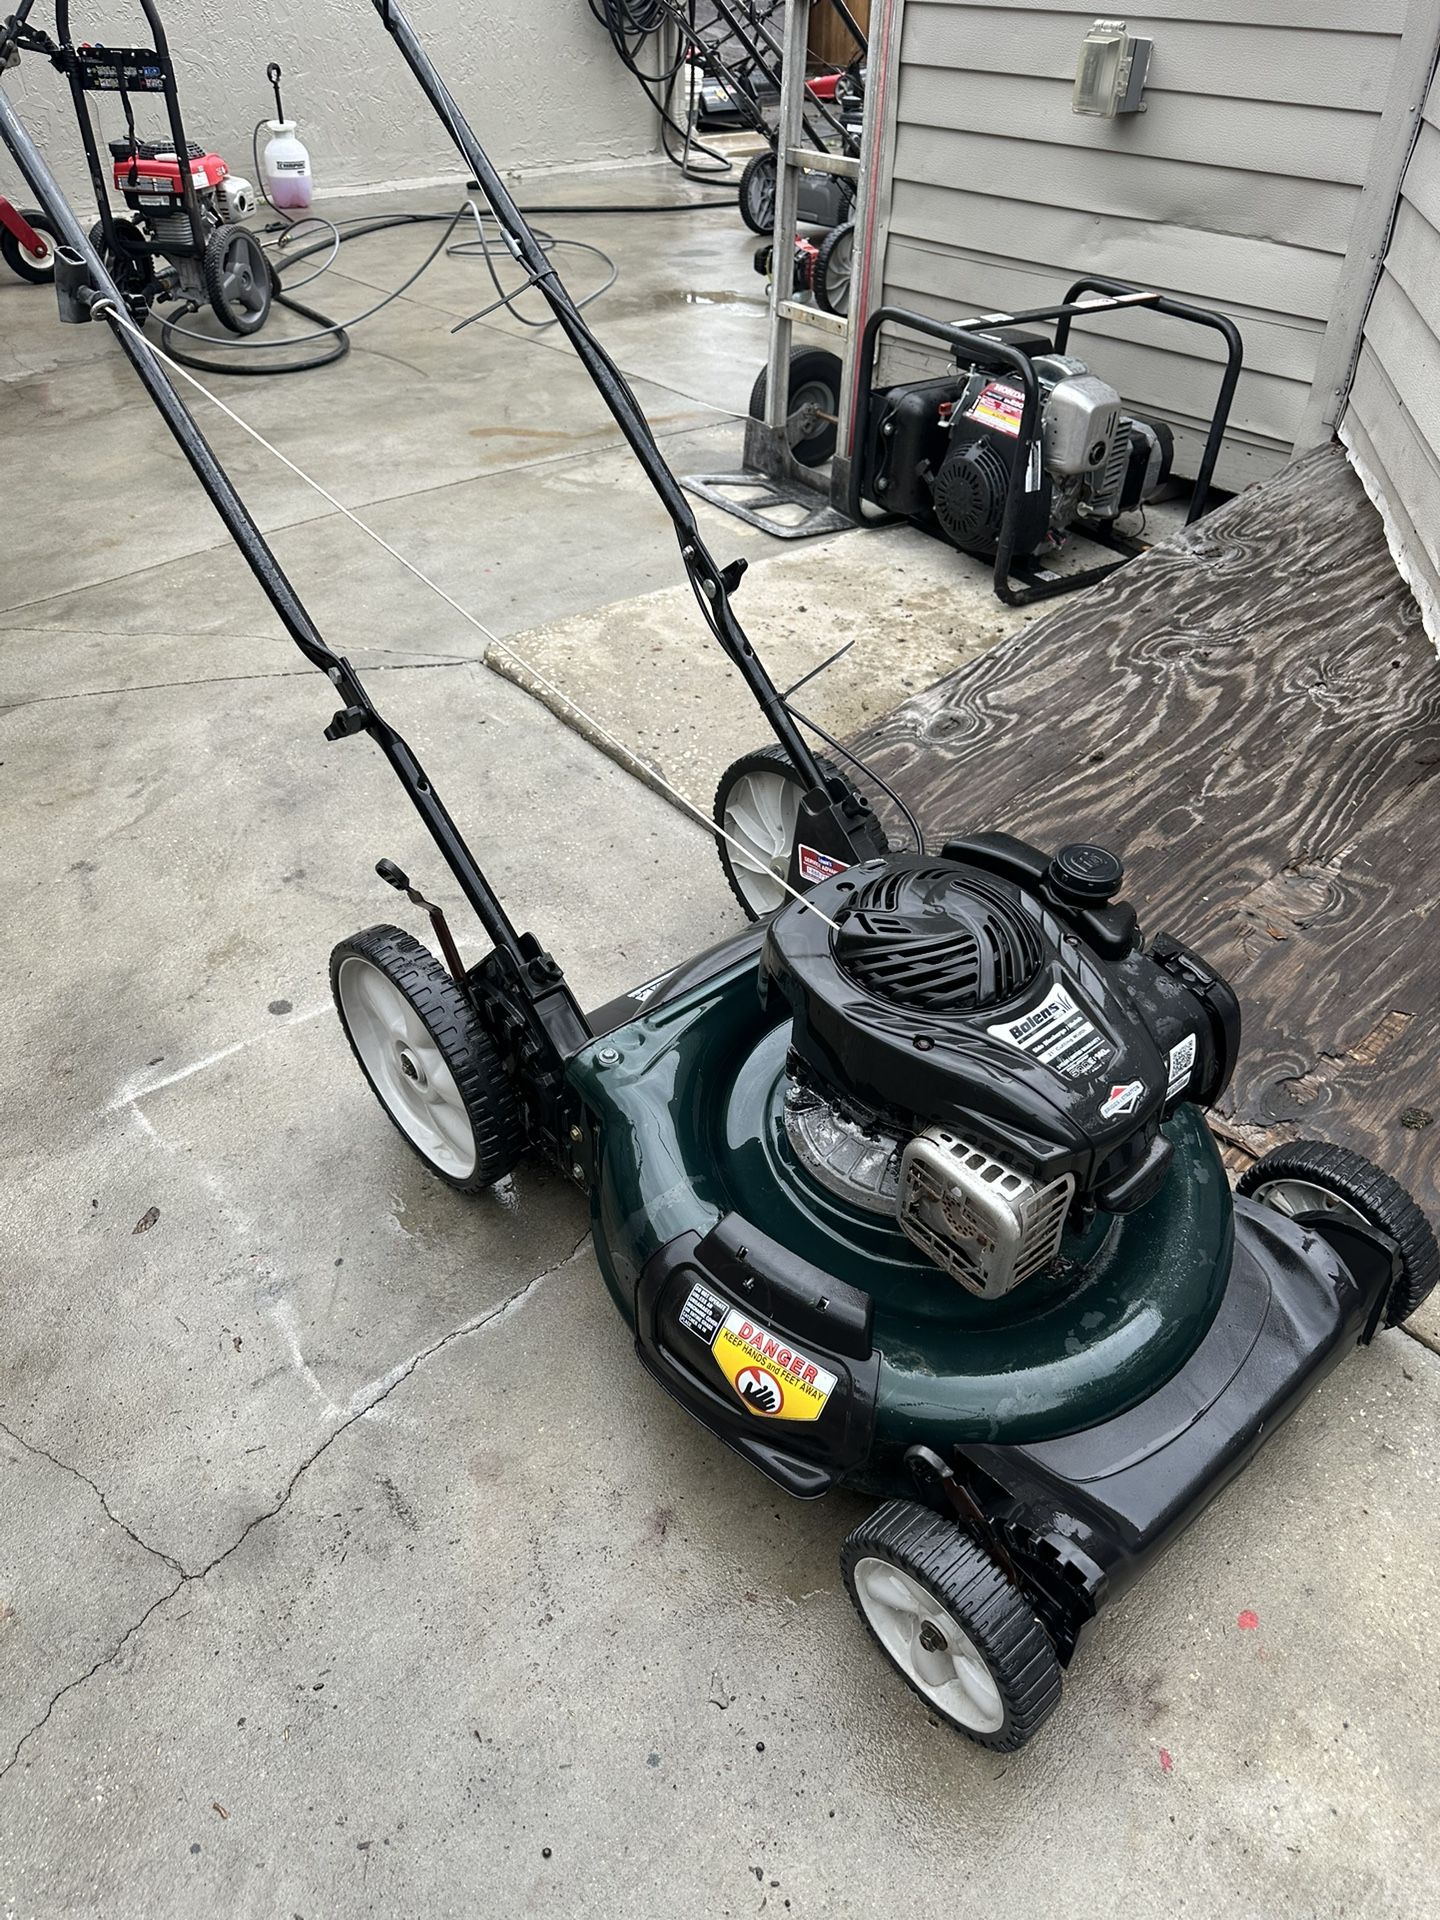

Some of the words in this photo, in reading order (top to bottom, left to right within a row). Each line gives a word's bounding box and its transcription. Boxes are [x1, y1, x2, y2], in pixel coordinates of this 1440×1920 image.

[1009, 1002, 1060, 1040] Bolens
[723, 1331, 743, 1348] KEEP
[742, 1344, 768, 1368] HANDS
[766, 1362, 781, 1375] and
[780, 1369, 801, 1387] FEET
[799, 1383, 824, 1401] AWAY
[738, 1322, 818, 1384] DANGER
